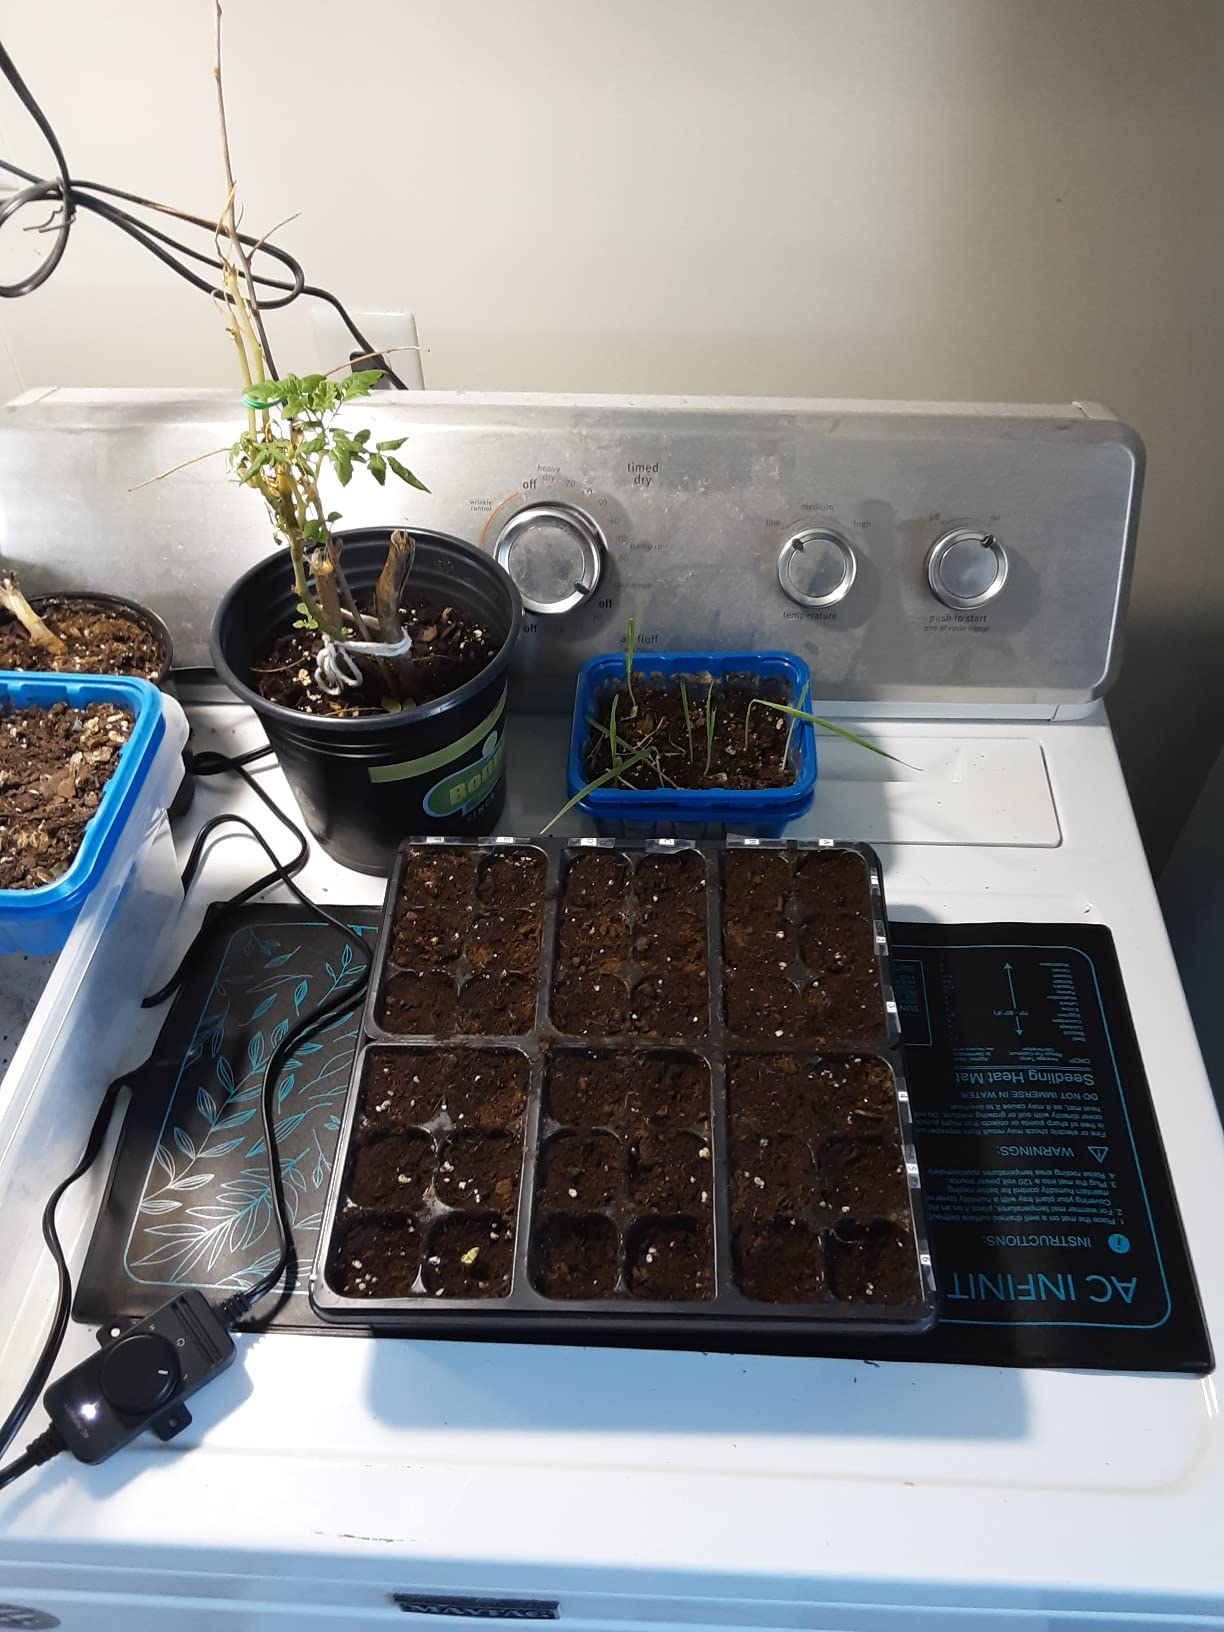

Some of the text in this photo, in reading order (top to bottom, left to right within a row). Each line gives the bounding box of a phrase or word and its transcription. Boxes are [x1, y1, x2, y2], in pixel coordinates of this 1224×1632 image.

[537, 464, 560, 473] heavy
[627, 462, 659, 473] timed
[543, 473, 556, 482] dry
[634, 474, 652, 486] dry
[522, 479, 537, 489] off
[853, 520, 871, 528] high
[598, 599, 612, 608] off
[783, 610, 837, 620] temperature
[929, 613, 952, 624] push
[523, 624, 537, 633] off
[637, 635, 658, 644] fluff
[954, 1070, 1095, 1086] Seedling Heat Mat
[998, 1090, 1009, 1099] IN
[1010, 1090, 1057, 1099] IMMERSE
[1059, 1091, 1081, 1100] NOT
[1082, 1092, 1098, 1101] DO
[996, 1145, 1075, 1157] WARNINGS:
[1088, 1179, 1107, 1188] Plug
[1036, 1195, 1055, 1204] plant
[1056, 1195, 1074, 1204] your
[1075, 1195, 1111, 1207] Covering
[1098, 1208, 1113, 1216] For
[1061, 1215, 1077, 1223] mat
[1078, 1216, 1092, 1224] the
[1093, 1216, 1116, 1225] Place
[982, 1234, 1092, 1248] INSTRUCTIONS:
[947, 1272, 1138, 1304] AC INFINIT
[409, 1603, 551, 1618] MAYTAG
